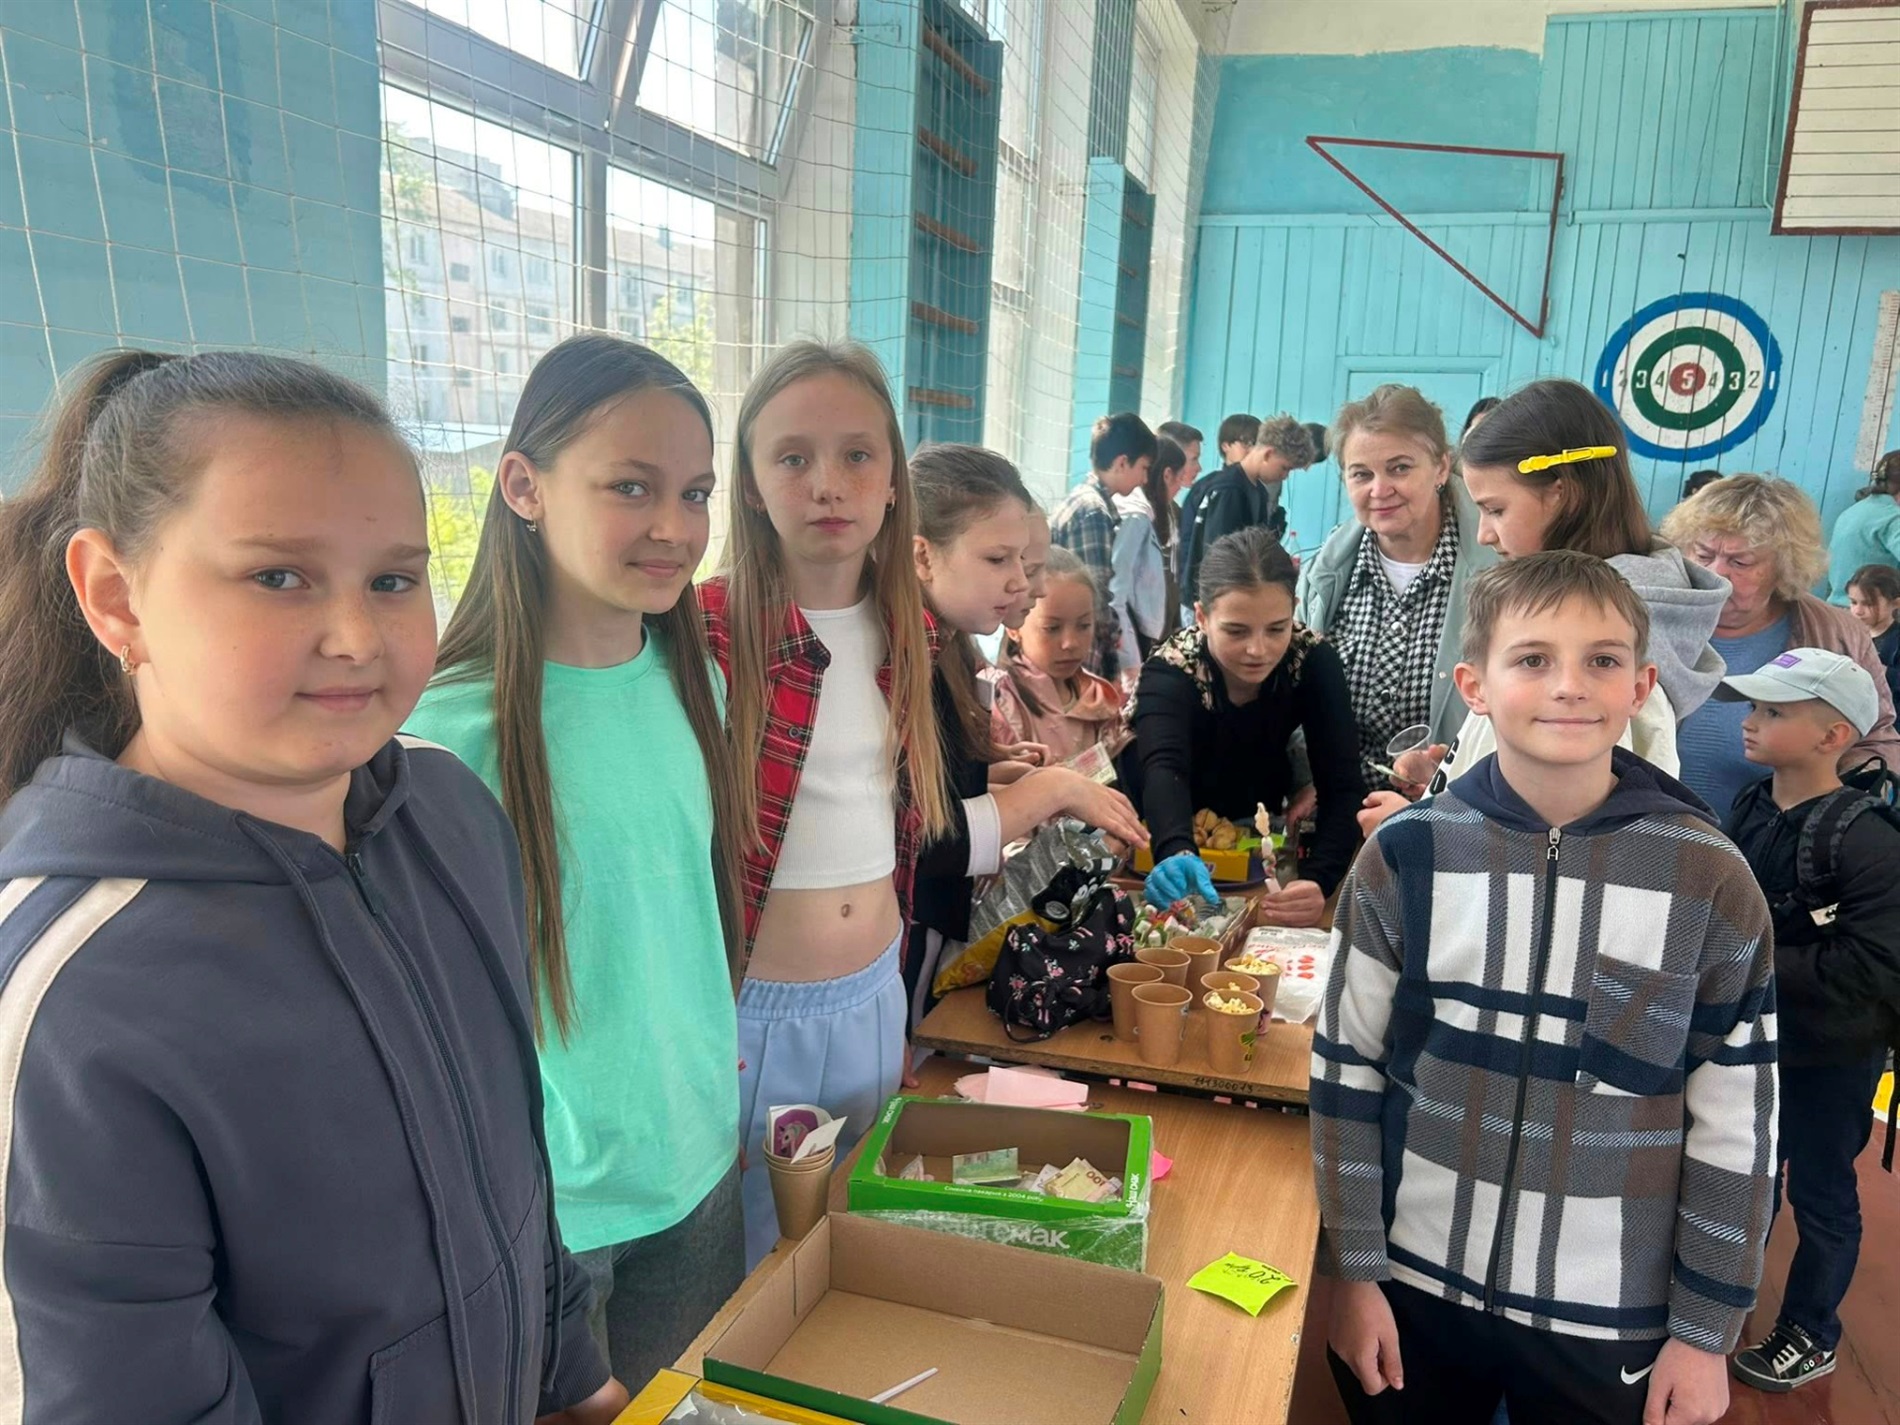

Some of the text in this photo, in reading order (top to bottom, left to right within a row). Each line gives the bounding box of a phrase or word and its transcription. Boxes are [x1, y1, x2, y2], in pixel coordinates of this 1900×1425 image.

[1618, 370, 1628, 388] 2
[1635, 369, 1647, 389] 3
[1655, 370, 1665, 388] 4
[1680, 369, 1694, 390] 5
[1708, 371, 1718, 388] 4
[1728, 371, 1741, 391] 3
[1747, 370, 1760, 389] 2
[1008, 1191, 1026, 1199] 2004
